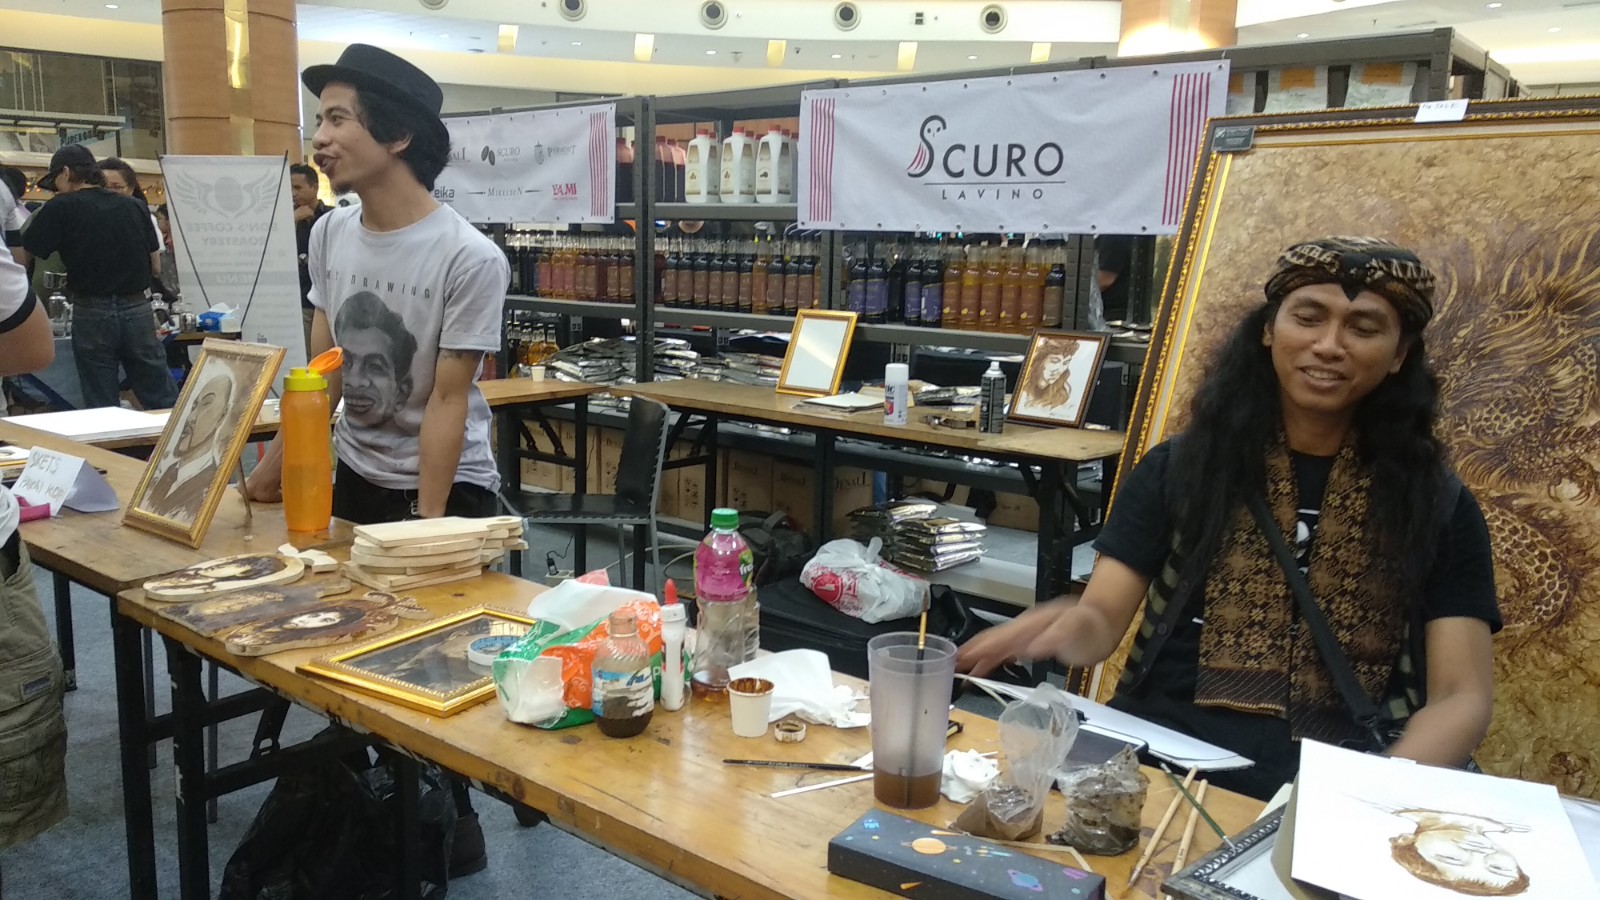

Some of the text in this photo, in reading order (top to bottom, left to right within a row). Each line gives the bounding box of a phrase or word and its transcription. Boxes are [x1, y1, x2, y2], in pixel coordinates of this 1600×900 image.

[906, 114, 1064, 178] SCURO
[941, 188, 1043, 201] LAVINO
[350, 274, 430, 299] DRAWING
